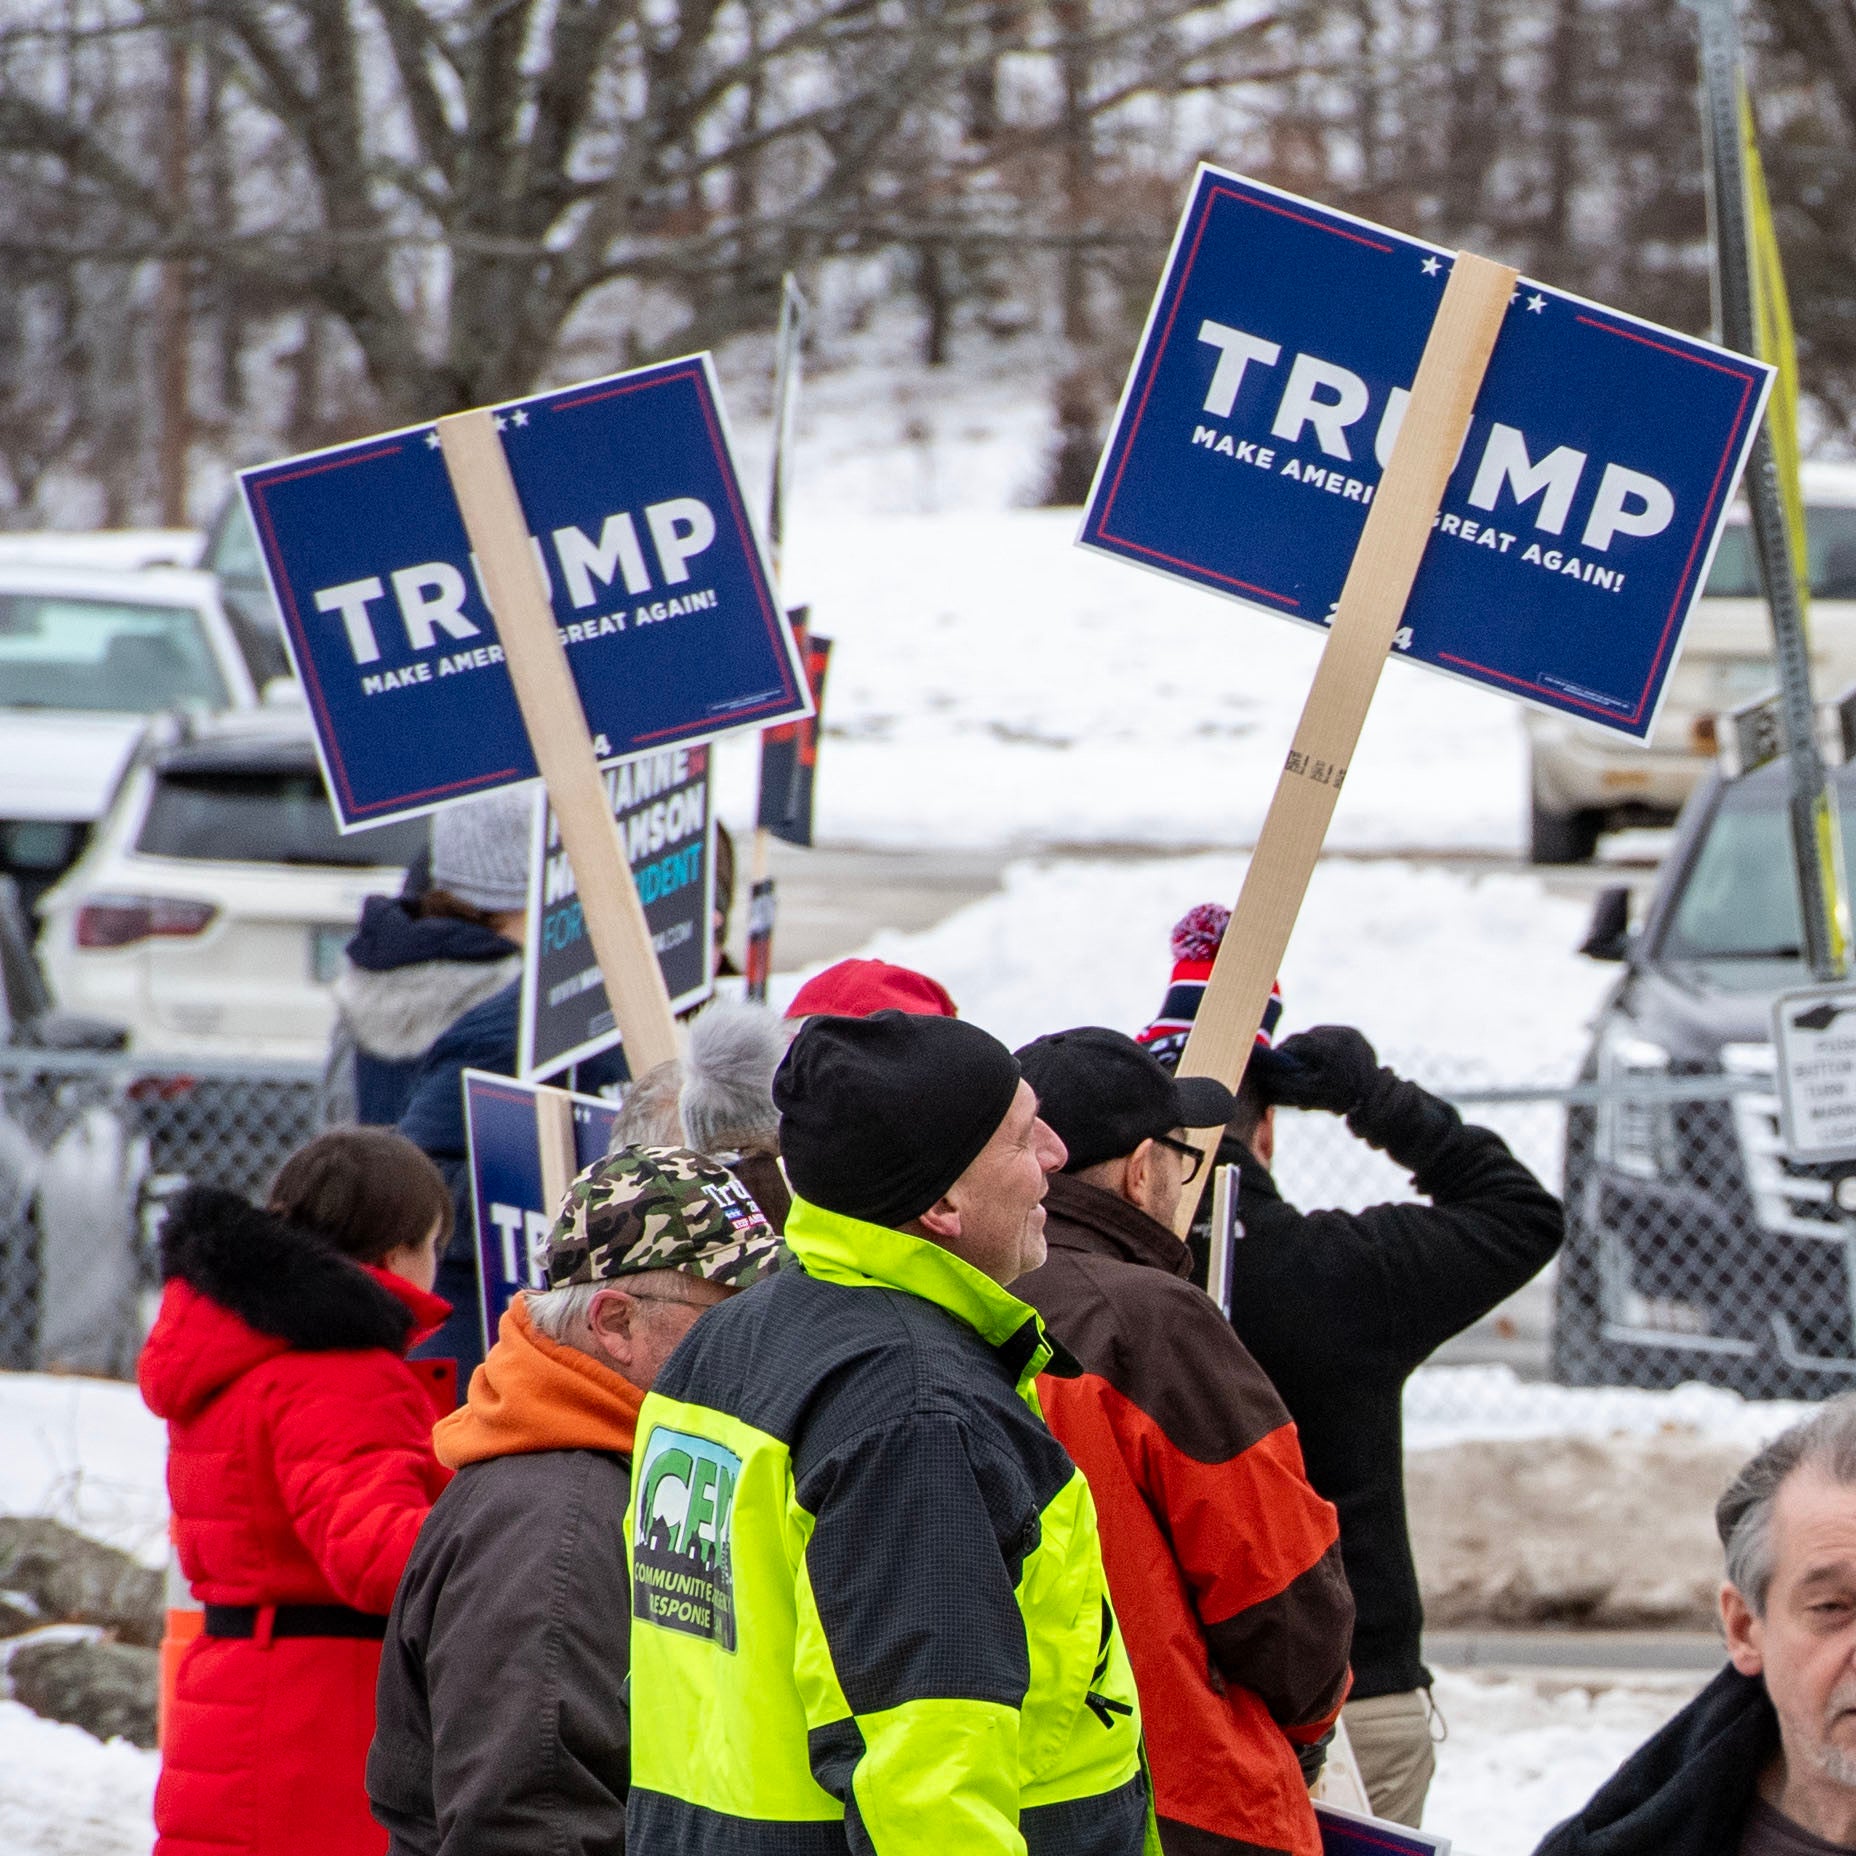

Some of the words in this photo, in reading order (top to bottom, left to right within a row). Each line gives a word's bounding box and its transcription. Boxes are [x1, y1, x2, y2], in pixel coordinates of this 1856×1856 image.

[1191, 424, 1274, 470] MAKE
[1281, 457, 1377, 505] AMERI
[1521, 542, 1626, 593] AGAIN!
[361, 661, 432, 696] MAKE
[438, 644, 507, 678] AMER
[635, 589, 717, 627] AGAIN!
[634, 842, 704, 905] IDENT
[634, 1561, 706, 1599] COMMUNITY
[650, 1593, 711, 1629] RESPONSE
